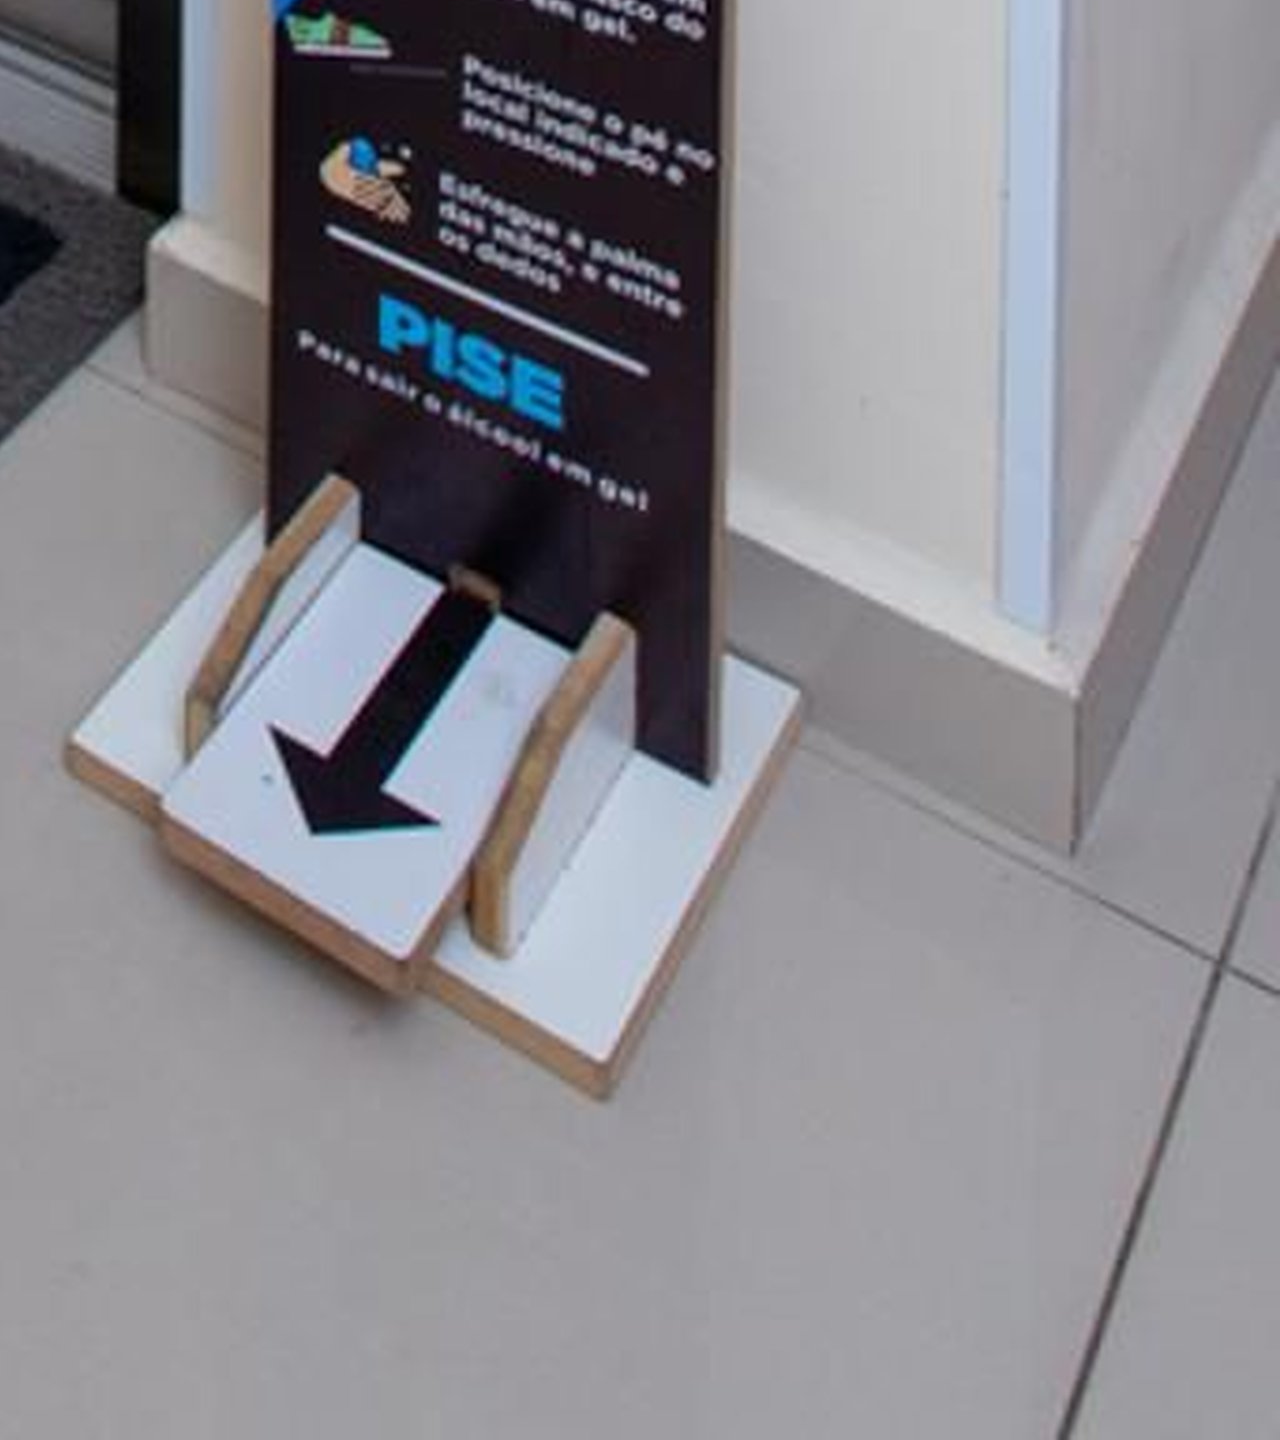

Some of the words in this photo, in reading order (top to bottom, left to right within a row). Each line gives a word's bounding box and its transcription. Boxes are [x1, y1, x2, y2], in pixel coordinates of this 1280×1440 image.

[664, 11, 705, 41] do
[606, 272, 683, 319] entre
[378, 293, 564, 430] PISE
[298, 329, 362, 376] Para
[546, 450, 593, 488] em
